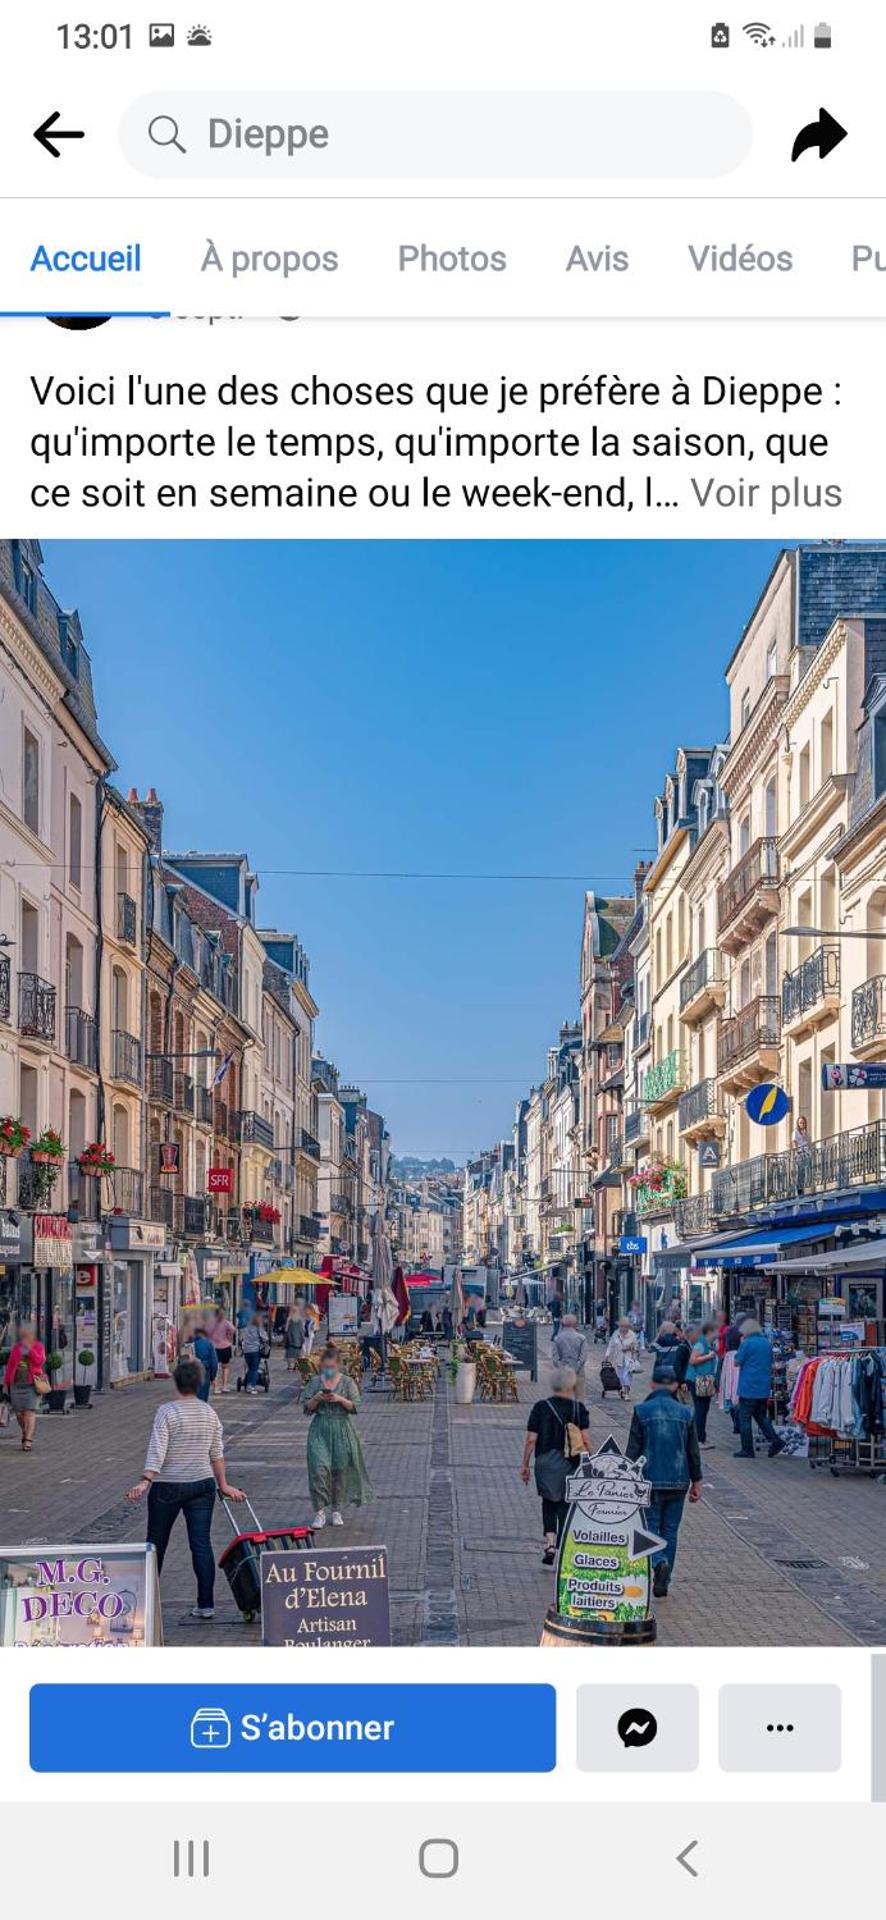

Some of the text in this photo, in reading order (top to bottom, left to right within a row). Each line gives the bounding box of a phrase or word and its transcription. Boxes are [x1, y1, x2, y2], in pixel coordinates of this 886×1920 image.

[56, 23, 131, 49] 13:01
[209, 118, 329, 156] Dieppe
[29, 243, 141, 271] Accueil
[201, 239, 339, 279] À propos
[399, 244, 507, 272] Photos
[565, 244, 629, 272] Avis
[687, 243, 793, 272] Vidéos
[29, 375, 115, 406] Voici
[129, 375, 206, 406] l'une
[218, 375, 278, 406] des
[290, 375, 414, 406] choses
[426, 383, 488, 414] que
[497, 376, 529, 414] je
[540, 374, 661, 414] préfère
[672, 375, 690, 406] à
[703, 376, 823, 414] Dieppe
[30, 425, 829, 464] qu'importe le temps, qu'importe la saison, que
[30, 484, 70, 507] ce
[82, 476, 146, 507] soit
[157, 484, 197, 507] en
[210, 476, 358, 507] semaine
[369, 484, 410, 507] ou
[422, 476, 452, 507] le
[461, 476, 634, 512] week-end,
[690, 476, 843, 515] Voir plus
[210, 1174, 230, 1187] SFR
[573, 1529, 626, 1544] Volailles
[36, 1558, 109, 1586] M.G.
[265, 1554, 386, 1584] Au Fournil
[574, 1554, 618, 1568] Glaces
[285, 1586, 369, 1609] d’Elena
[568, 1579, 622, 1593] Produits
[21, 1591, 124, 1622] DECO
[573, 1595, 616, 1609] laitiers
[297, 1617, 358, 1633] Artisan
